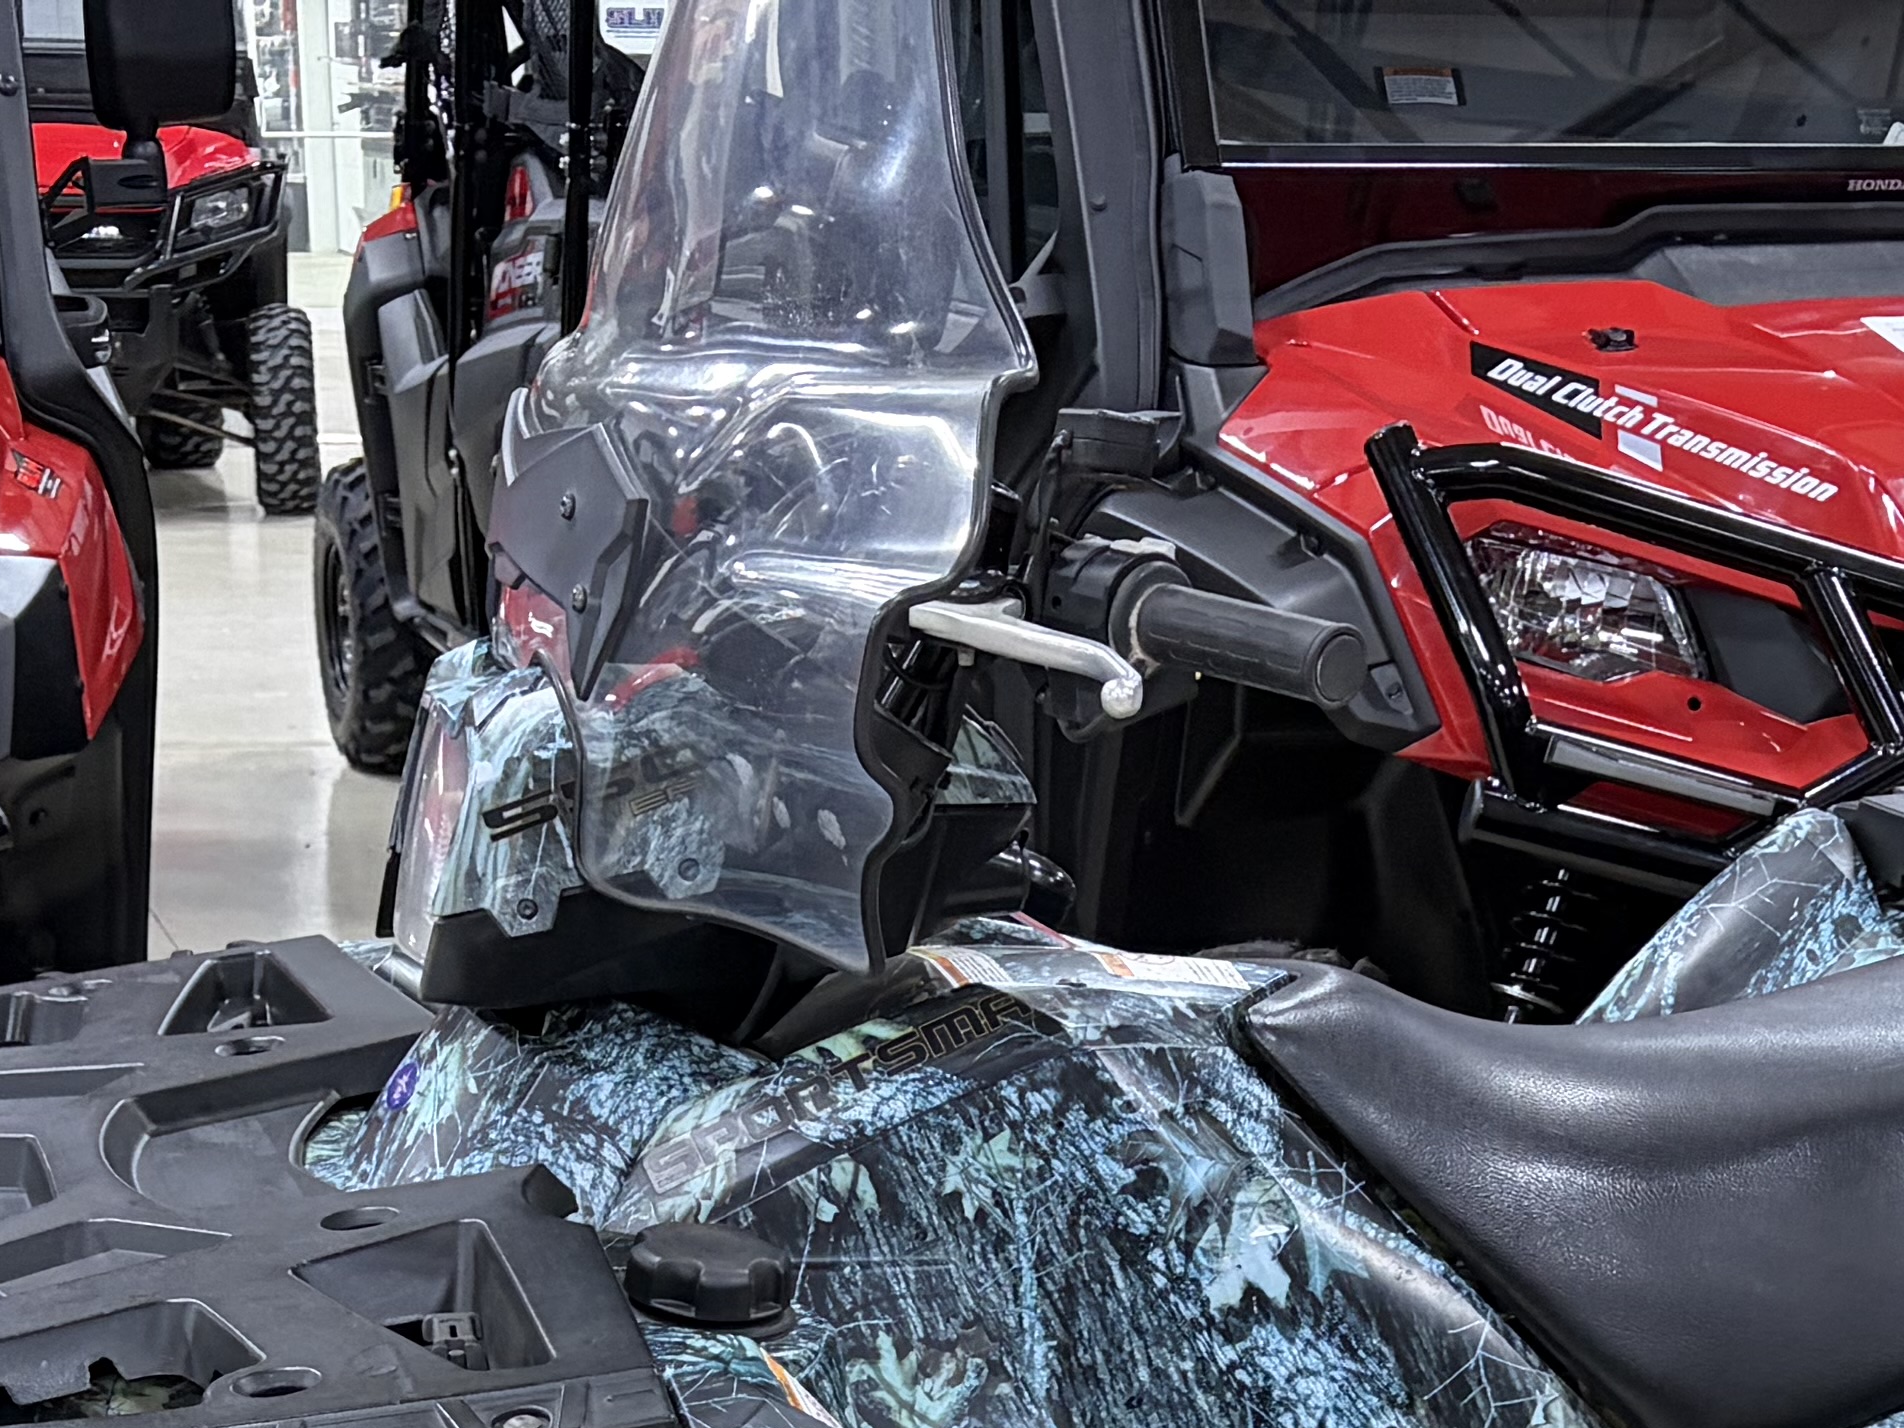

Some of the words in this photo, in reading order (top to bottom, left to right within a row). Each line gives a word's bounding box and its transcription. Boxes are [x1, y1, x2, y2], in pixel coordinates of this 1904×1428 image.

[1487, 357, 1561, 396] Dual
[1552, 381, 1647, 429] Clutch
[1644, 412, 1839, 502] Transmission
[643, 994, 1031, 1194] SPORTSMA
